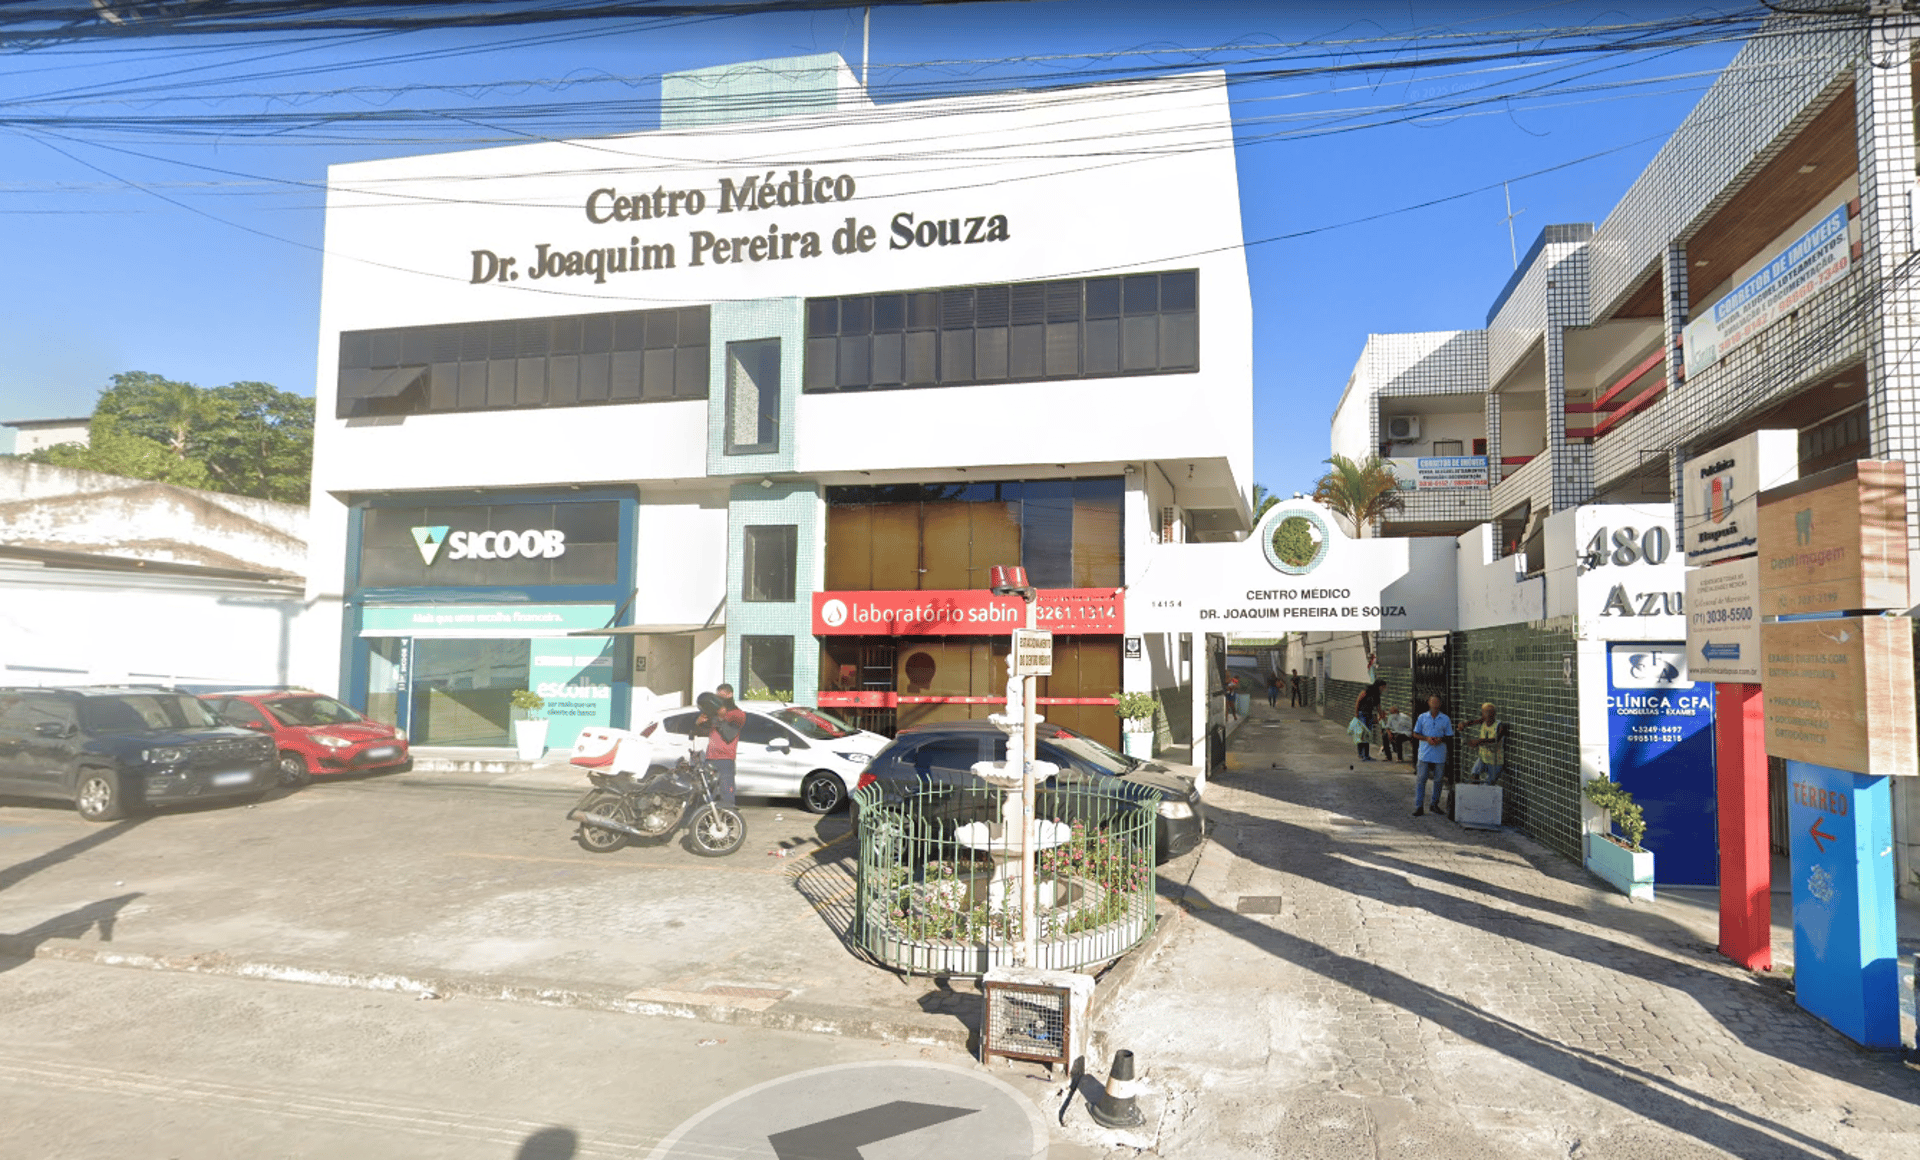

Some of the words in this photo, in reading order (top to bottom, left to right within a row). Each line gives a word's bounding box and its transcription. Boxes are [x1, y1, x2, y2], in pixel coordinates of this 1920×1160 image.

[586, 186, 706, 224] Centro
[717, 168, 856, 213] Médico
[470, 250, 519, 285] Dr.
[528, 236, 676, 285] Joaquim
[688, 223, 822, 267] Pereira
[832, 217, 877, 255] de
[889, 211, 1011, 250] Souza
[1718, 269, 1771, 319] CORRETOR
[1771, 255, 1787, 278] DE
[1788, 213, 1841, 267] IMÓVEIS
[449, 529, 566, 559] SICOOB
[1585, 526, 1671, 567] 480
[1246, 590, 1298, 601] CENTRO
[1301, 587, 1351, 600] MÉDICO
[853, 602, 964, 623] laboratório
[968, 602, 1018, 622] sabin
[1200, 609, 1220, 619] DR.
[1224, 608, 1280, 619] JOAQUIM
[1283, 607, 1338, 618] PEREIRA
[1341, 607, 1359, 617] DE
[1362, 605, 1407, 617] SOUZA
[1706, 606, 1753, 624] 3038-5500
[1606, 693, 1671, 708] CLÍNICA
[1678, 696, 1710, 709] CFA
[1617, 707, 1660, 716] CONSULTAS
[1665, 707, 1697, 717] EXAMES
[1793, 780, 1849, 817] TÉRREO
